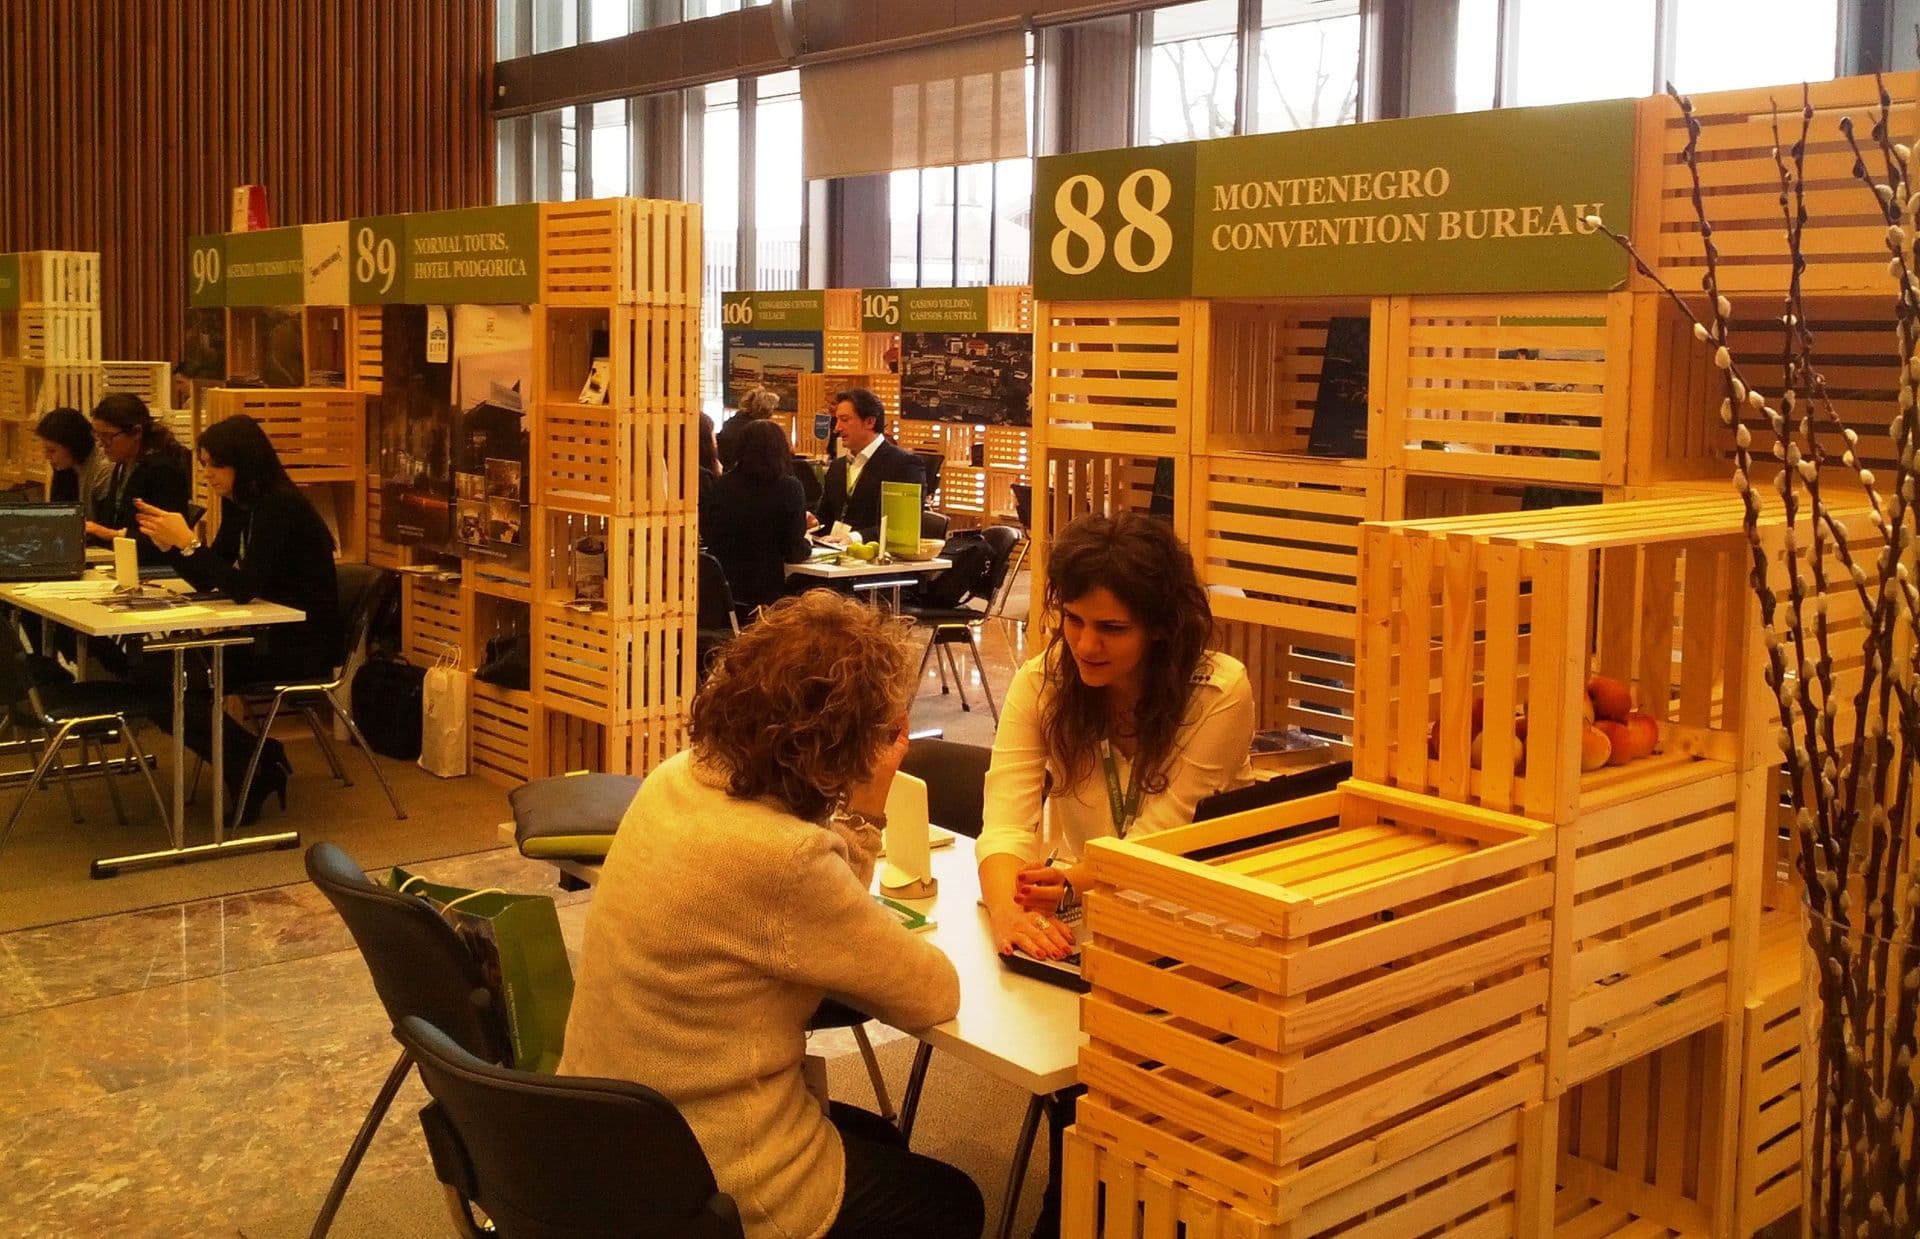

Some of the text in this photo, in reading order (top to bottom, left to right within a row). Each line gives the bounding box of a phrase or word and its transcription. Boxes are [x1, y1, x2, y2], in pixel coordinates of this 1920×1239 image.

[1213, 167, 1450, 213] MONTENEGRO
[1050, 168, 1173, 276] 88
[1212, 203, 1605, 252] CONVENTION BUREAU
[357, 226, 397, 296] 89
[414, 258, 527, 279] HOTEL PODGORICA
[415, 237, 462, 255] NORMAL
[192, 247, 219, 295] 90
[722, 296, 753, 325] 106
[864, 294, 900, 324] 105
